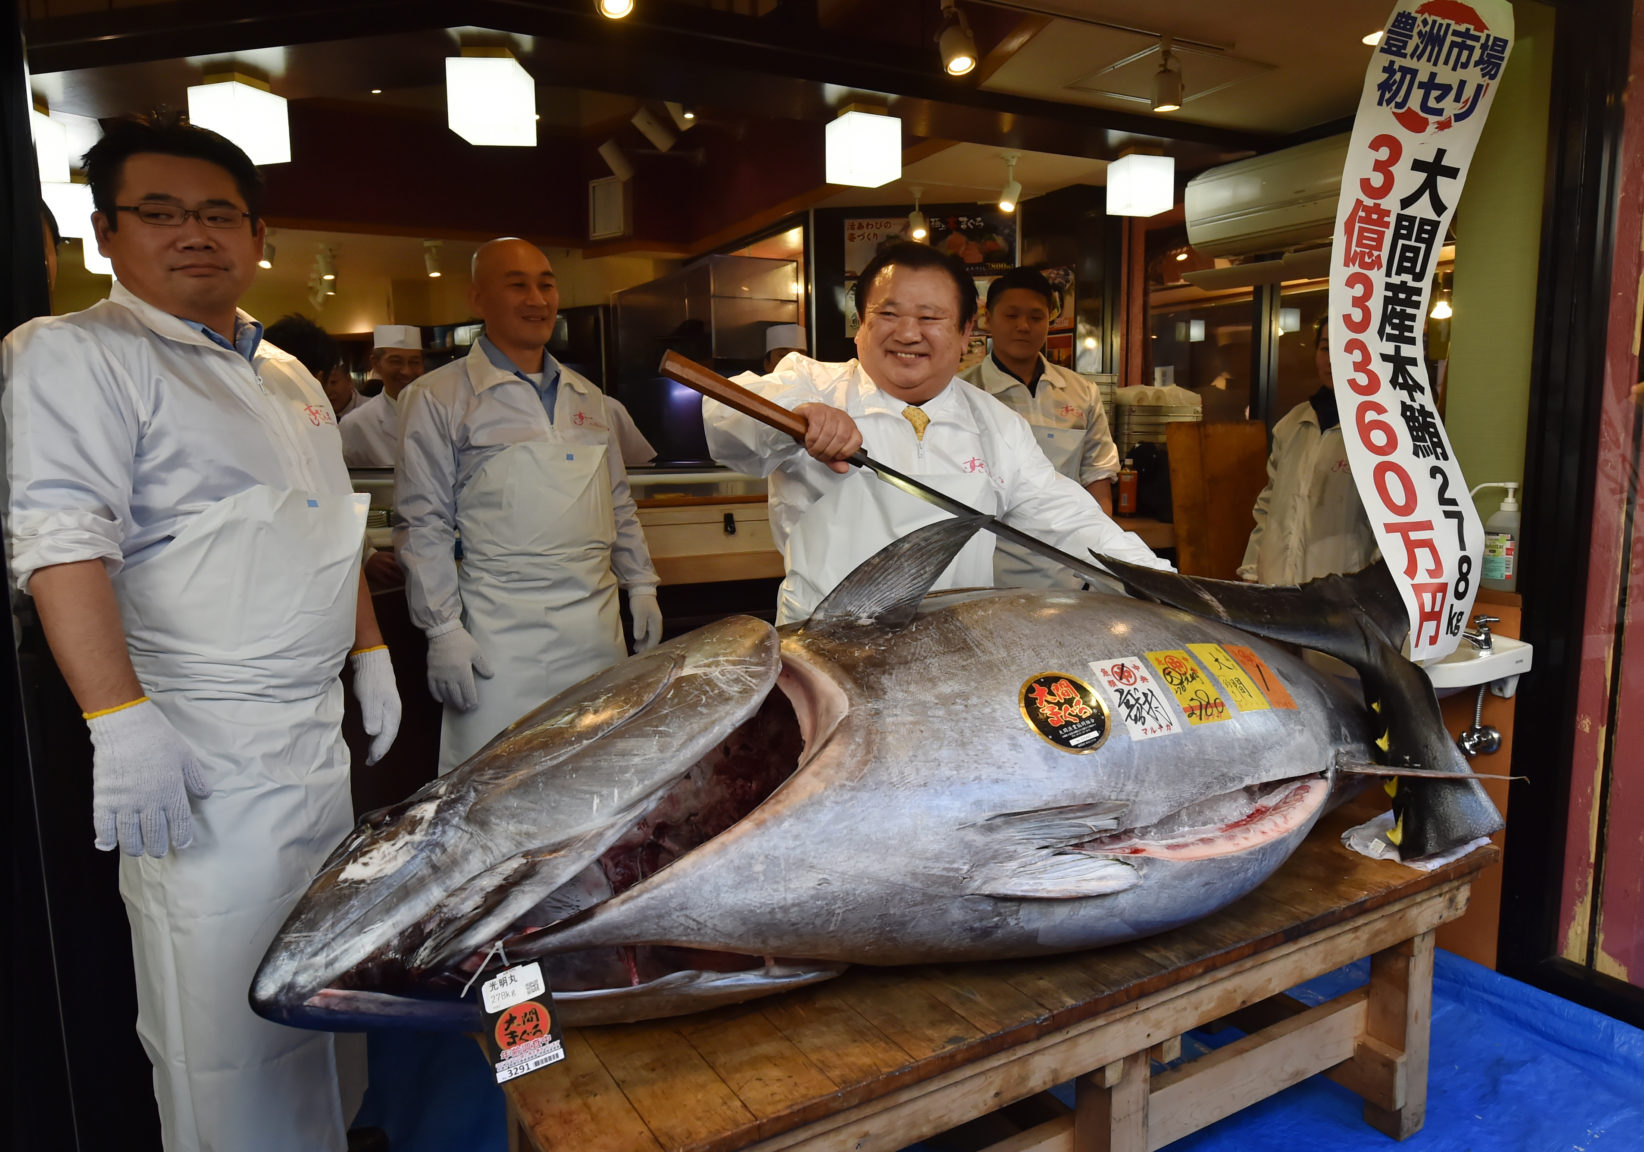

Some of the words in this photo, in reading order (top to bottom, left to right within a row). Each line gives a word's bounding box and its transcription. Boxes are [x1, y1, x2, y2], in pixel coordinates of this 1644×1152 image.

[1379, 10, 1509, 81] 豊洲市場
[1376, 60, 1484, 123] 初セリ
[1342, 133, 1448, 648] 3億3360万円
[1028, 678, 1080, 707] 大間
[1039, 698, 1093, 728] まぐろ
[489, 973, 519, 992] 光明丸
[503, 1007, 541, 1032] 大間
[503, 1023, 544, 1047] まぐろ
[507, 1063, 532, 1078] 3291
